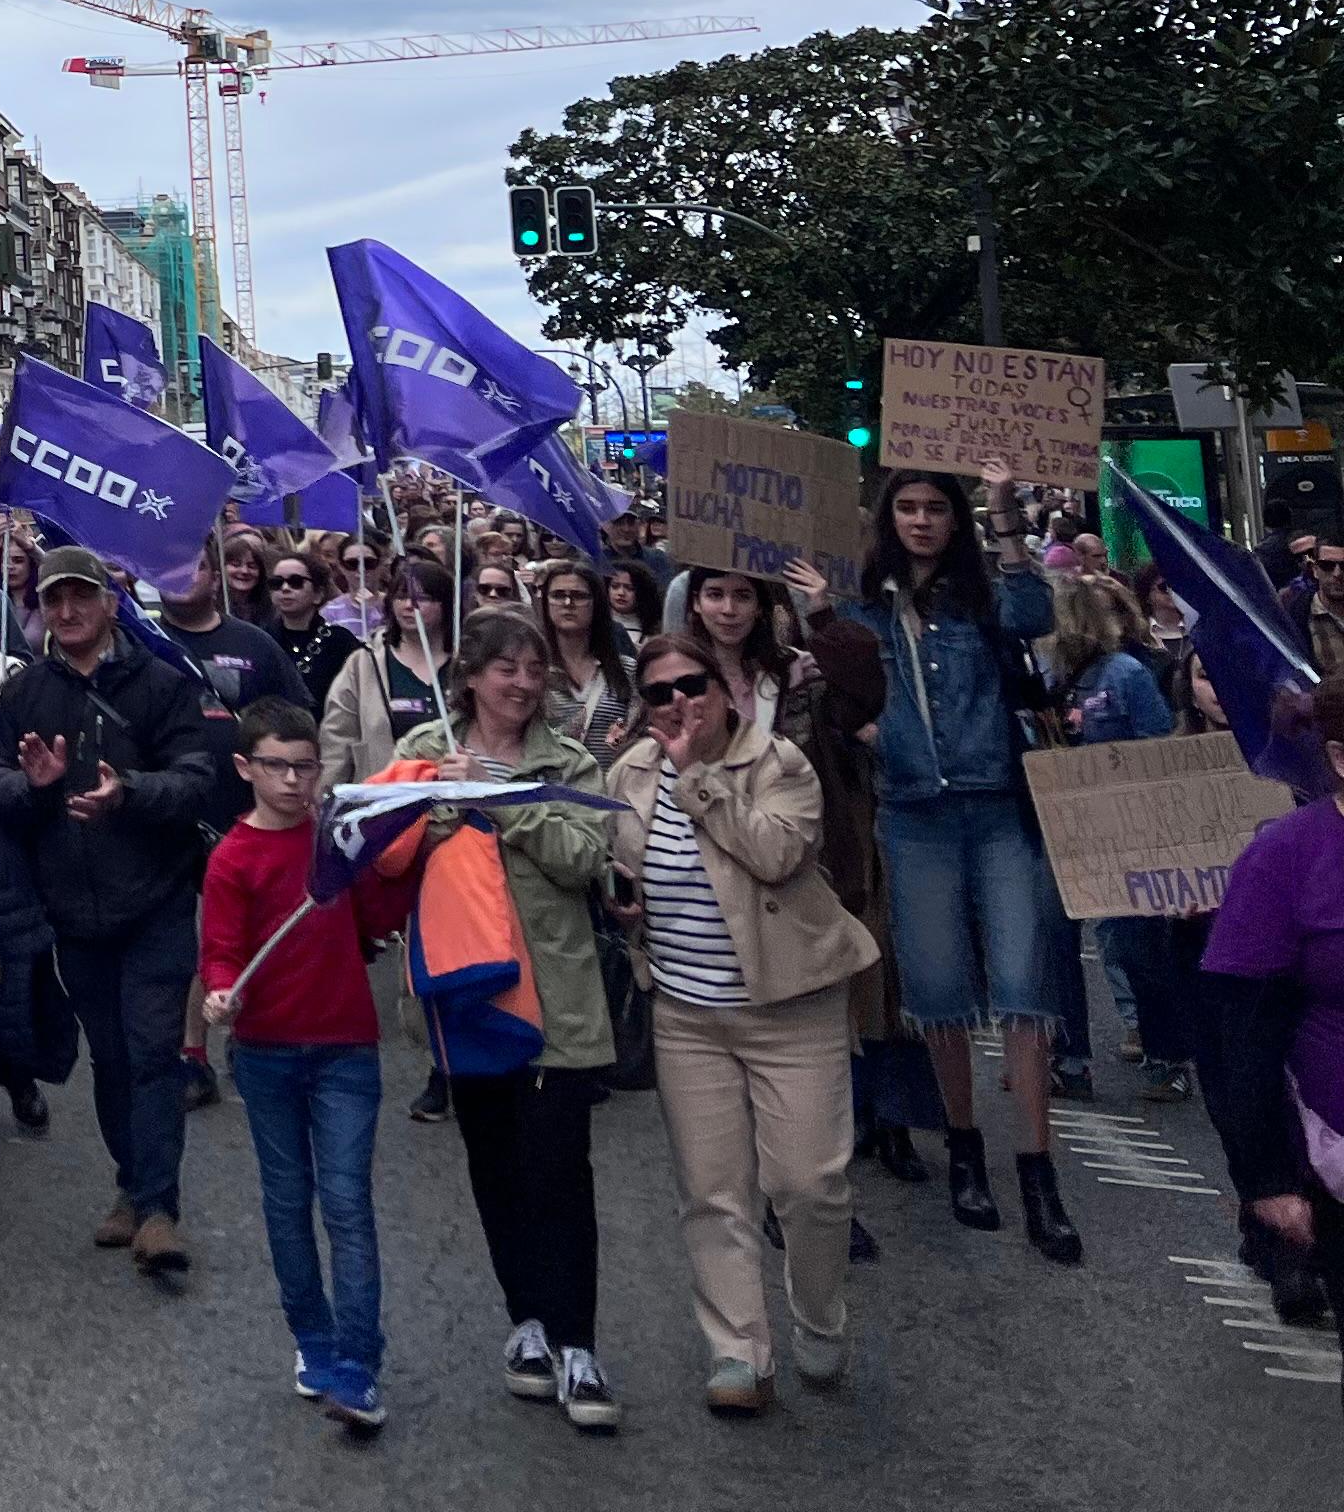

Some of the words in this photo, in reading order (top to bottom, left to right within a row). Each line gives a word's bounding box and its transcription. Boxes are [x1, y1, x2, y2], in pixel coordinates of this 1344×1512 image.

[890, 344, 945, 370] HOY
[953, 350, 994, 375] NO
[951, 374, 1030, 400] TODAS
[902, 391, 1001, 416] NUESTRAS
[1011, 402, 1071, 425] VOCES
[949, 412, 1035, 438] JUNTAS
[10, 425, 138, 508] CCOO
[710, 458, 803, 511] MOTIVO
[674, 486, 745, 532] LUCHA
[1123, 866, 1199, 912] PUTA
